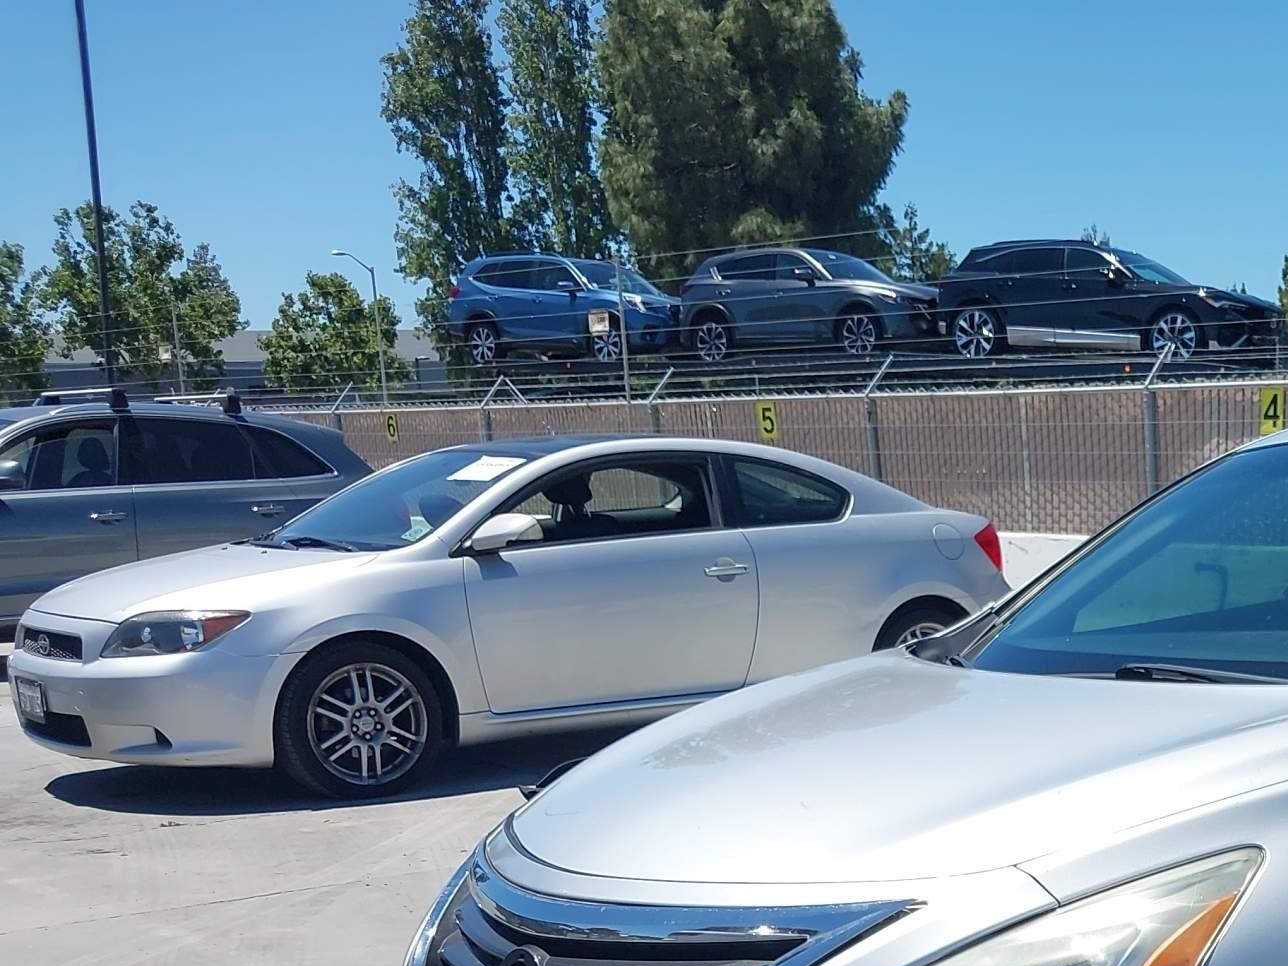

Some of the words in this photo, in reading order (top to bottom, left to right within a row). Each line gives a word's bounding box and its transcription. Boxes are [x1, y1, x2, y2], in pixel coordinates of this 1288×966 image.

[761, 407, 775, 434] 5
[1263, 392, 1281, 429] 4
[386, 415, 396, 438] 6
